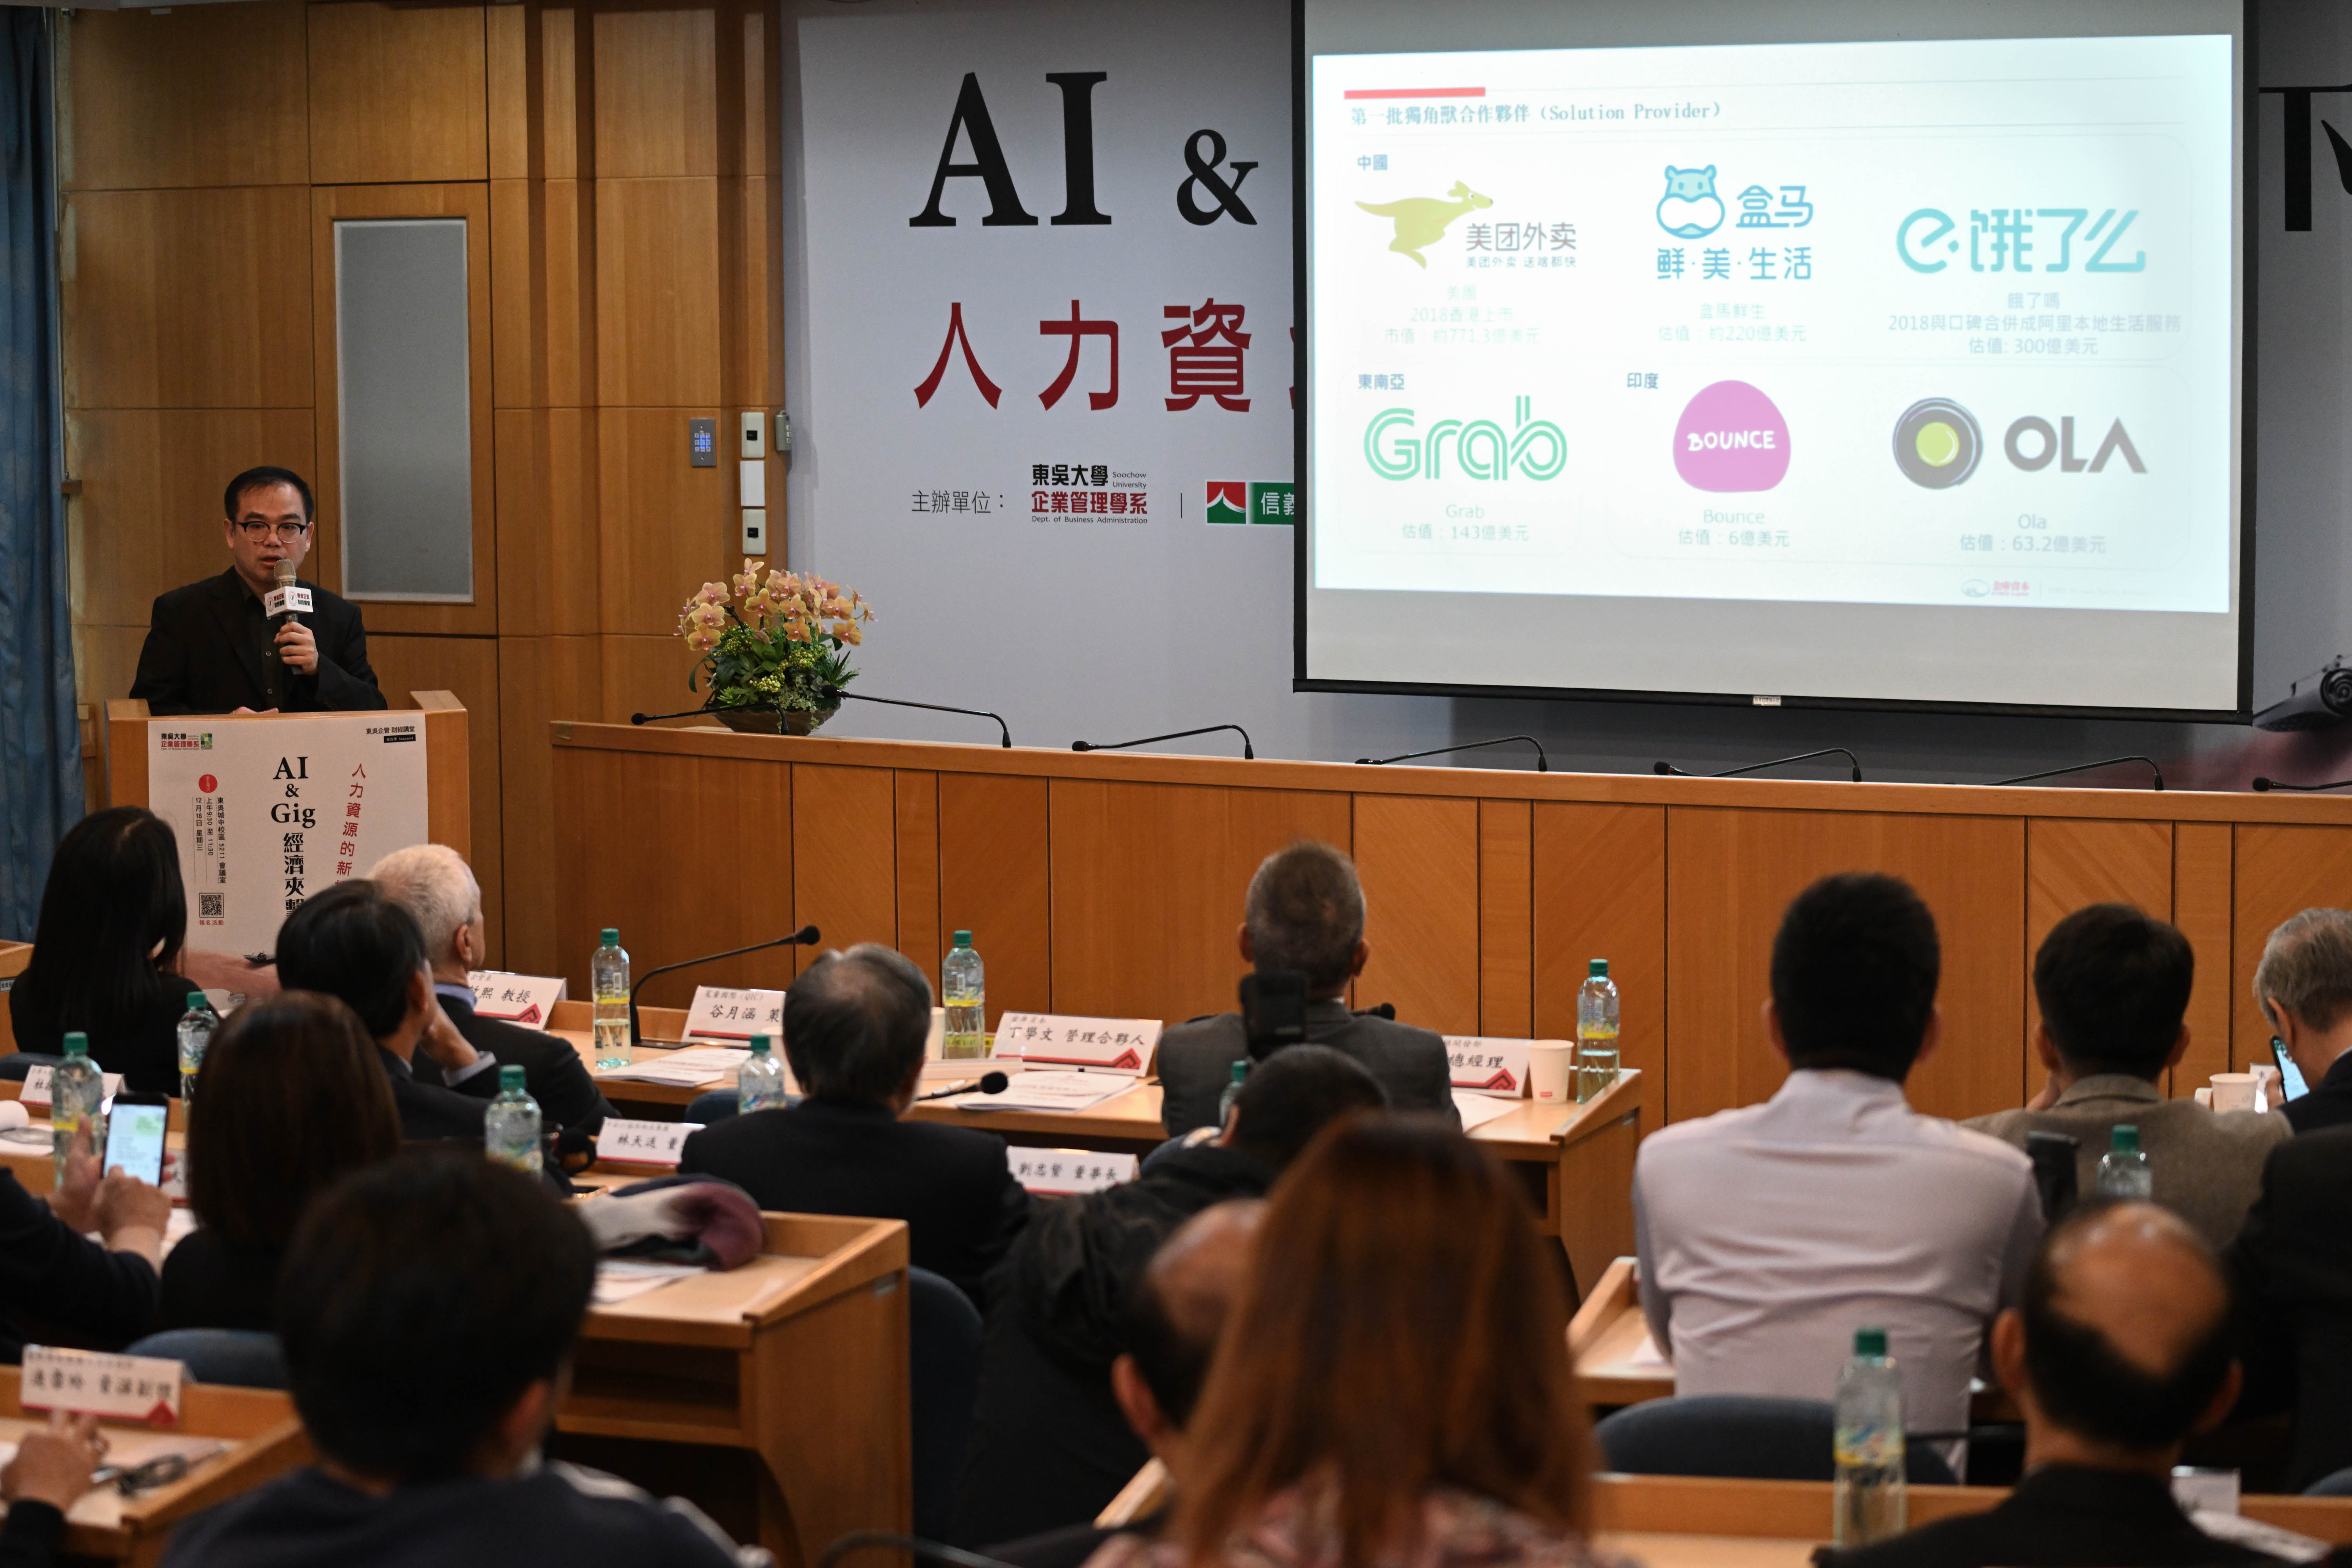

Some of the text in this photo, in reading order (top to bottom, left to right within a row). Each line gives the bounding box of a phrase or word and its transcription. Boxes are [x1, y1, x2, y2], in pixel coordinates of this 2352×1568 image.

[1351, 105, 1530, 126] 第一批獨角獸合作夥伴
[909, 72, 1258, 227] AI &
[1357, 154, 1388, 171] 中國
[1736, 185, 1814, 228] 盒马
[1466, 222, 1577, 251] 美团外卖
[1699, 303, 1766, 320] 盒馬鮮生
[2007, 292, 2060, 311] 餓了嗎
[914, 298, 1294, 413] 人力資
[1357, 374, 1405, 391] 東南亞
[1627, 372, 1659, 390] 印度
[1364, 395, 1568, 481] Grab
[1687, 430, 1777, 452] BOUNCE
[2004, 415, 2149, 474] OLA
[1033, 464, 1108, 486] 東吳大學
[1032, 491, 1147, 514] 企業管理學系
[1445, 504, 1485, 520] Grab
[1703, 509, 1766, 524] Bounce
[2018, 514, 2047, 530] Ola
[273, 757, 309, 779] AI
[285, 784, 299, 798] &
[271, 803, 316, 828] Gig
[335, 763, 366, 886] 人力資源的新
[502, 988, 531, 1003] 教授
[710, 1004, 756, 1020] 谷月涵
[1009, 1026, 1053, 1041] 丁學文
[1065, 1029, 1145, 1045] 管理合夥人
